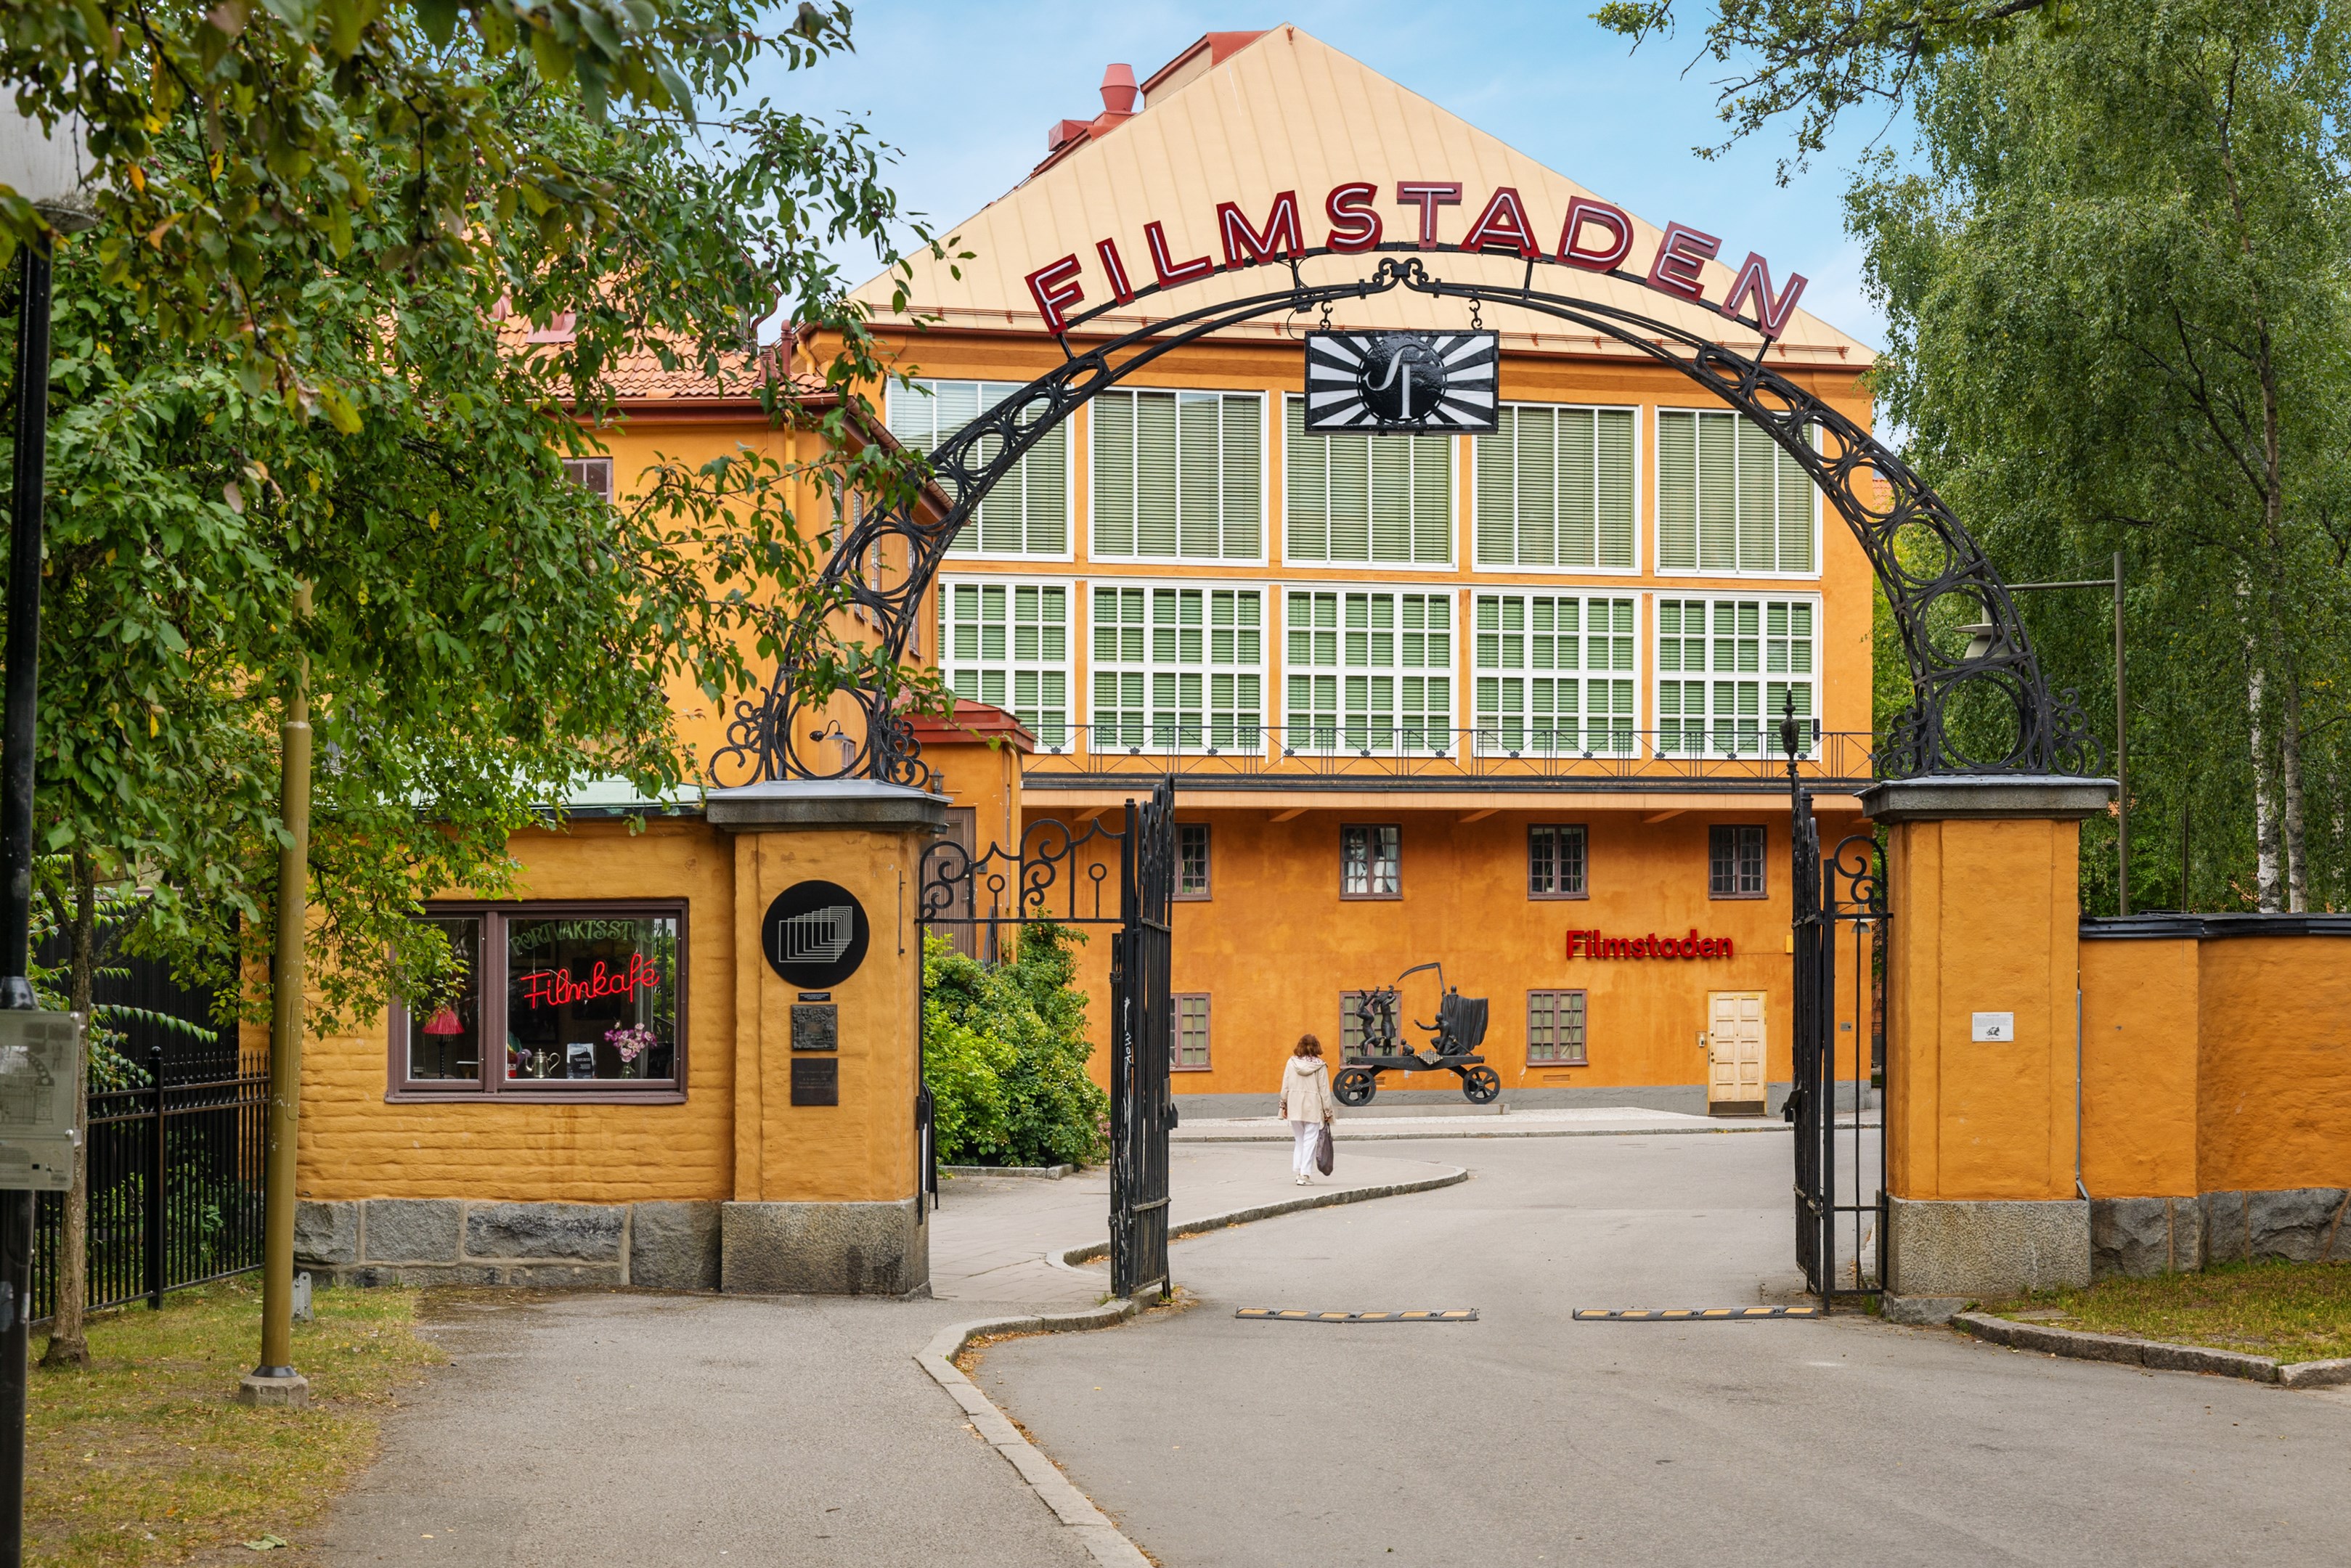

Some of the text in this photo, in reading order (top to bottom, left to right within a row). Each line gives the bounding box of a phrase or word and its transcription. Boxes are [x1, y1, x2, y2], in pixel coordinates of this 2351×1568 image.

[1024, 180, 1809, 342] FILMSTADEN
[1566, 929, 1734, 958] Filmstaden
[521, 953, 660, 1009] Filmkafé
